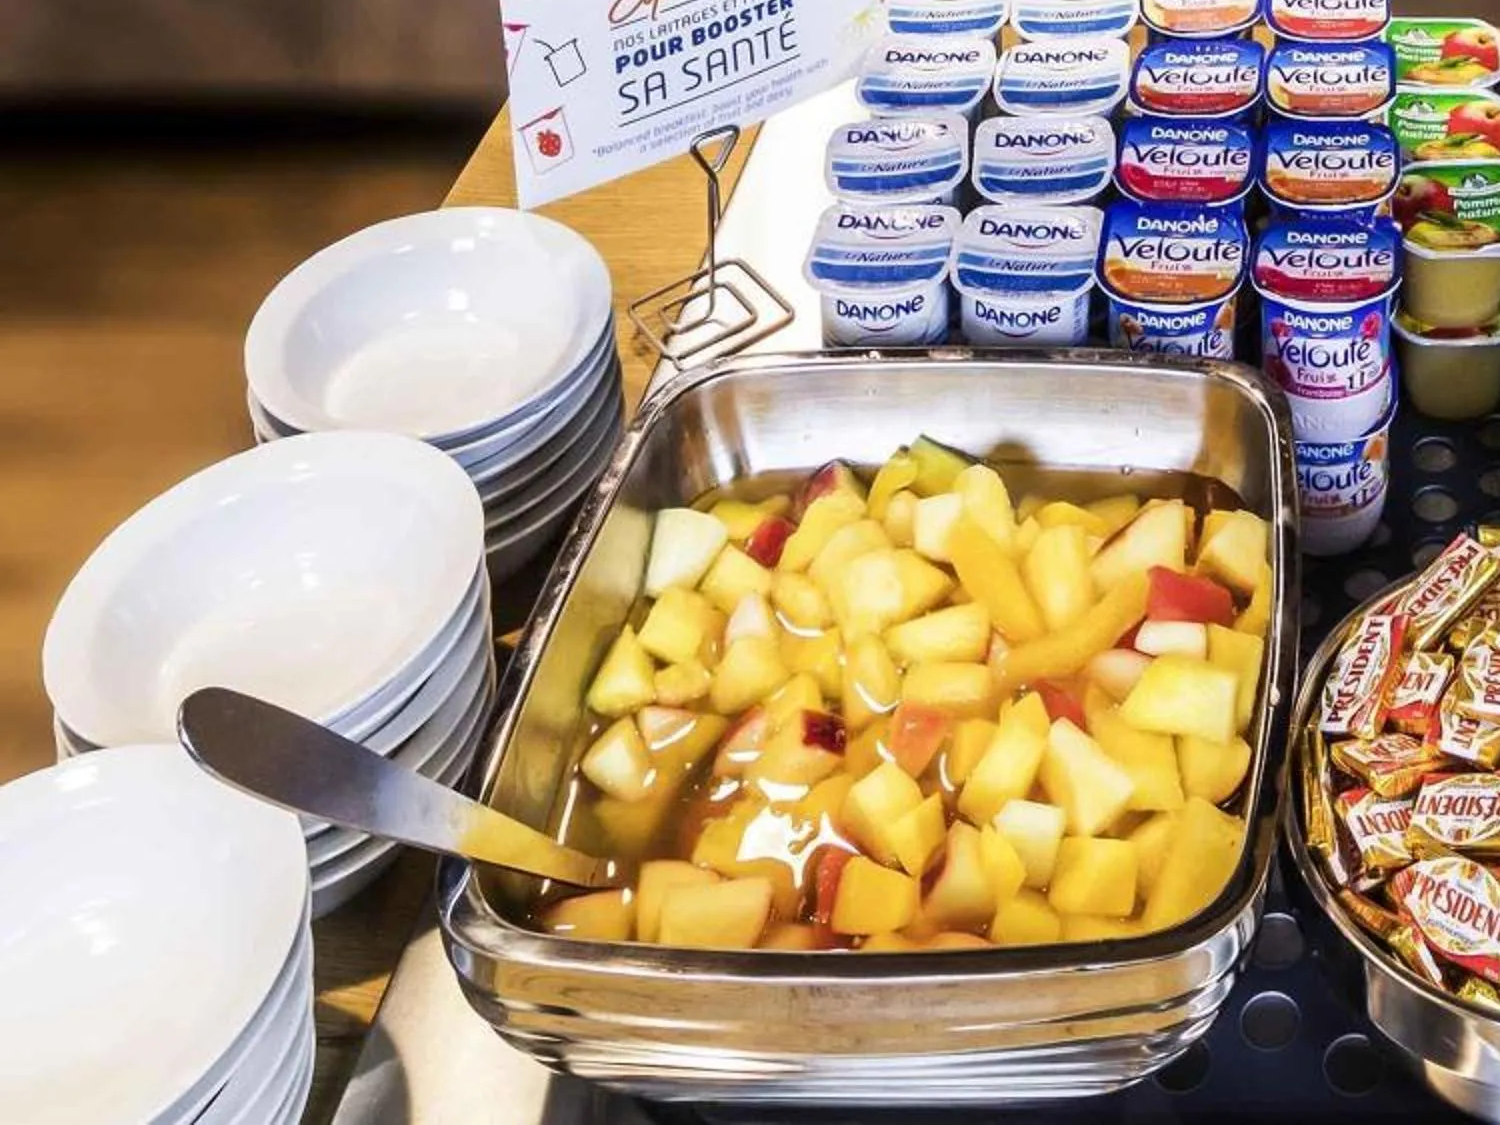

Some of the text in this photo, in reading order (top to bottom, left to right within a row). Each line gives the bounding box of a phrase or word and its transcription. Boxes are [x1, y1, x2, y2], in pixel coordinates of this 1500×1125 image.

[614, 34, 644, 52] NOS
[649, 9, 719, 43] LAITAGES
[615, 35, 684, 74] POUR
[618, 12, 799, 116] SA SANTÉ
[1129, 141, 1248, 167] Velouté
[1274, 148, 1393, 171] Velouté
[1116, 233, 1241, 262] Velouté
[1262, 246, 1392, 269] Velouté
[1276, 335, 1372, 368] Velouté
[1297, 444, 1355, 460] ANONE
[1327, 618, 1385, 723] PRÉSIDENT
